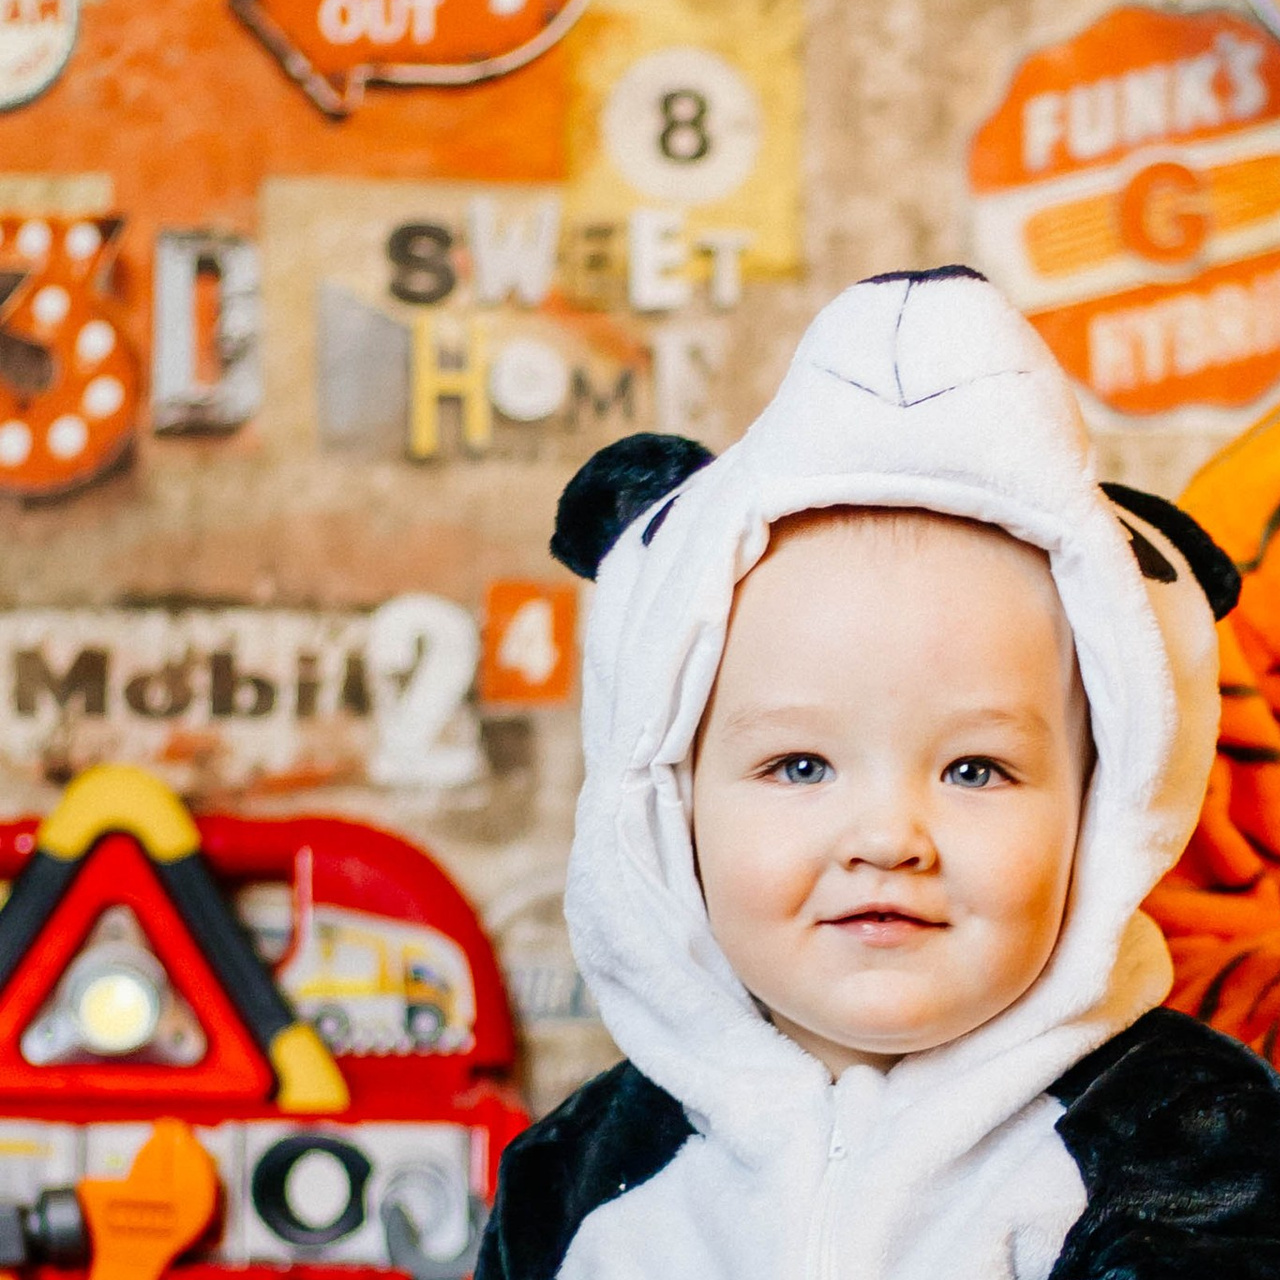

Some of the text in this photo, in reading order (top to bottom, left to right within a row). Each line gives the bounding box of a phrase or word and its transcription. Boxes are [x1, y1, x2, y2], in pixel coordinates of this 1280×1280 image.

[659, 89, 710, 164] 8
[1118, 160, 1208, 265] G
[498, 599, 558, 684] 4
[366, 592, 482, 788] 2
